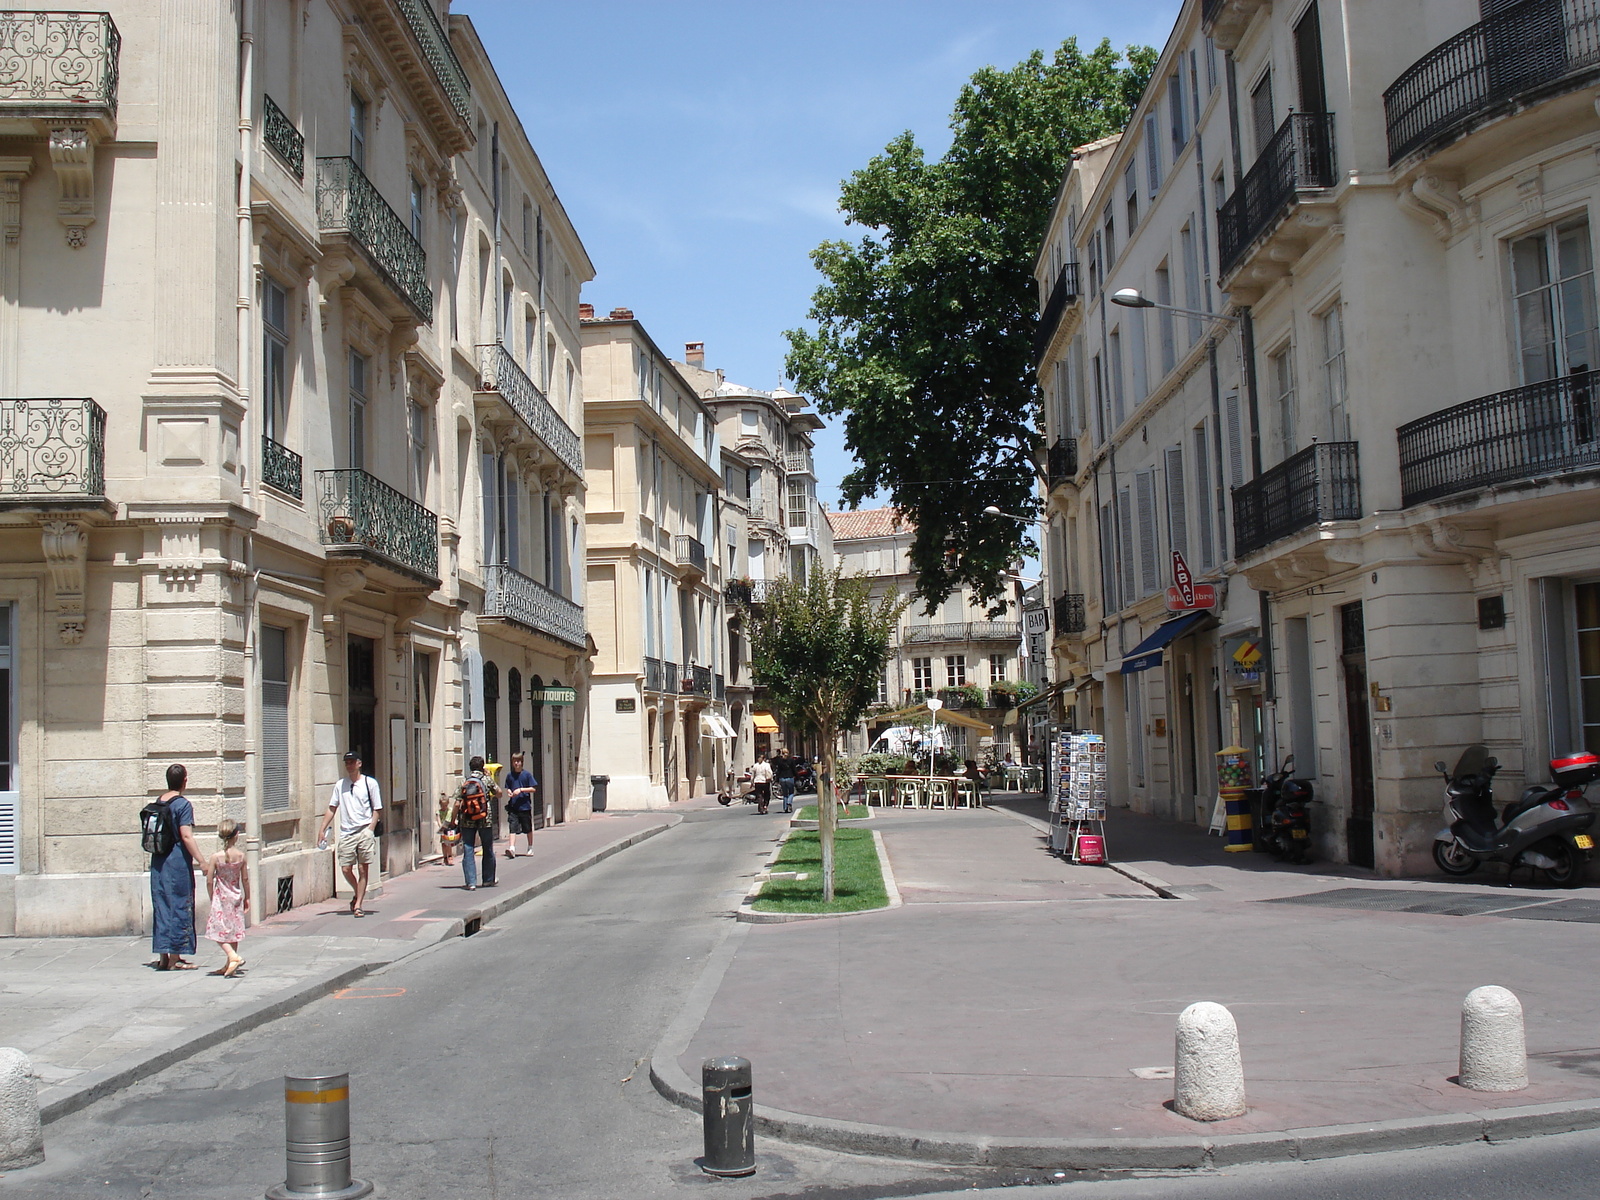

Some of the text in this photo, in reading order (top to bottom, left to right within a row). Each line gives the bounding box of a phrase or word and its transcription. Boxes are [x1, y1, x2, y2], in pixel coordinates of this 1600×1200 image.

[1173, 554, 1192, 602] TABAC
[1194, 593, 1214, 601] ibre
[1028, 612, 1045, 628] BAR
[1233, 666, 1265, 674] TABAC
[532, 689, 575, 702] ANTIQUITÉS
